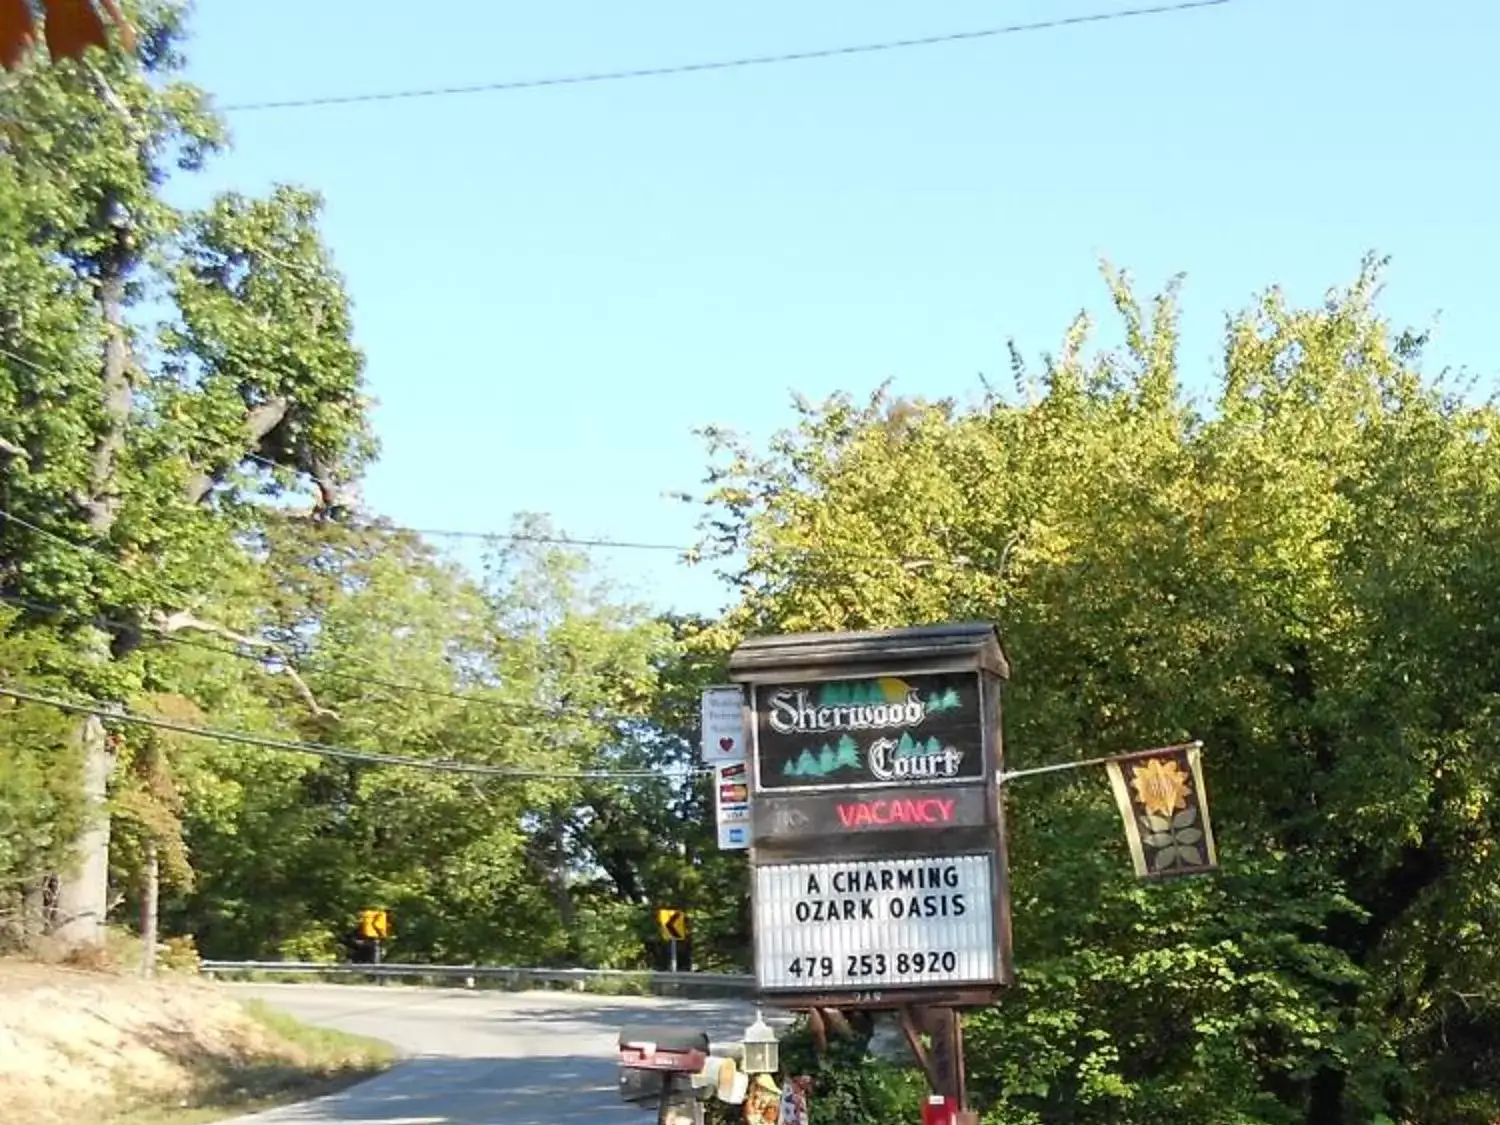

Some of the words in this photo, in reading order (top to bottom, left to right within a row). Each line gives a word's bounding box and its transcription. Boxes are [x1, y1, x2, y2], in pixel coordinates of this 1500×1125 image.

[768, 687, 926, 734] Sherwood
[868, 737, 963, 781] Court
[836, 799, 956, 827] VACANCY
[807, 873, 820, 894] A
[833, 866, 959, 893] CHARMING
[795, 899, 874, 922] OZARK
[890, 895, 966, 918] OASIS
[789, 957, 833, 977] 479
[847, 954, 887, 976] 253
[896, 951, 956, 974] 8920
